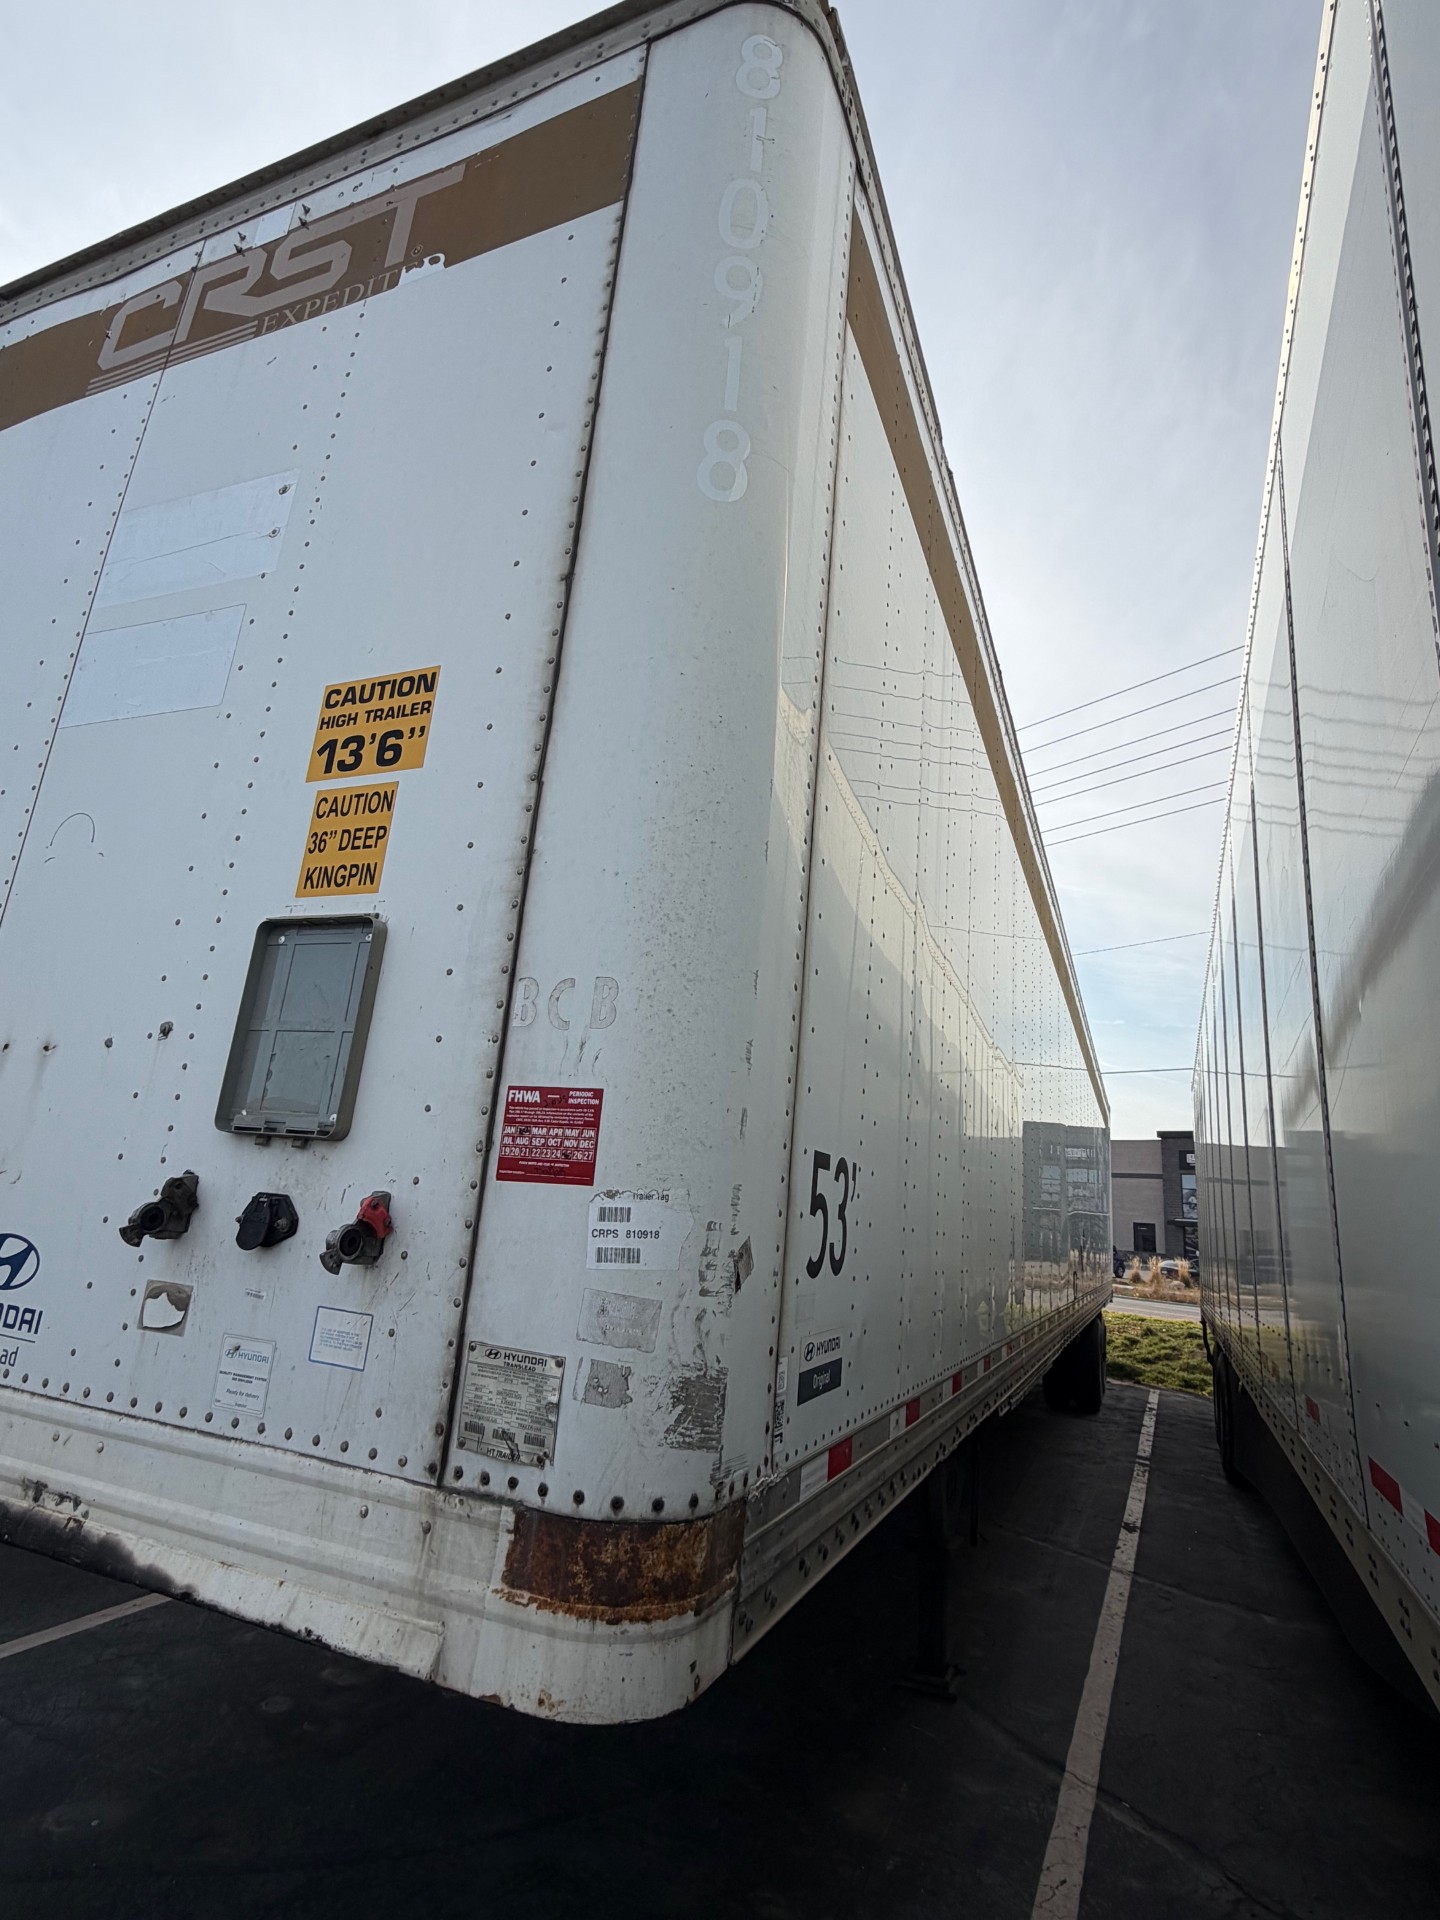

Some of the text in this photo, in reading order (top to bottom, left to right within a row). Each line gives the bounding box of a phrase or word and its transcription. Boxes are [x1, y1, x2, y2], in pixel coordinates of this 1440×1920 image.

[98, 163, 466, 370] CRST
[324, 672, 437, 709] CAUTION
[319, 700, 432, 730] HIGH TRAILER
[316, 790, 395, 819] CAUTION
[338, 826, 387, 851] DEEP
[303, 862, 378, 890] KINGPIN
[508, 1090, 540, 1103] FHWA
[503, 1126, 516, 1134] JAN
[531, 1127, 547, 1136] MAR
[549, 1128, 563, 1136] APR
[564, 1128, 580, 1137] MAY
[581, 1129, 595, 1138] JUN
[502, 1136, 594, 1148] JUL AUG SEP OCT NOV DEC
[501, 1147, 510, 1155] 19
[510, 1148, 519, 1156] 20
[520, 1148, 529, 1156] 21
[531, 1149, 540, 1157] 22
[541, 1149, 551, 1157] 23
[552, 1150, 561, 1158] 24
[573, 1151, 582, 1159] 26
[583, 1151, 593, 1160] 27
[591, 1229, 660, 1239] CRPS 810918
[0, 1302, 43, 1334] DAI
[816, 1335, 841, 1357] HYUNDAI
[238, 1352, 269, 1364] HYUNDAI
[504, 1352, 547, 1366] HYUNDAI
[503, 1362, 536, 1372] TRANSLEAD
[812, 1369, 831, 1389] Original
[486, 1448, 495, 1456] HT
